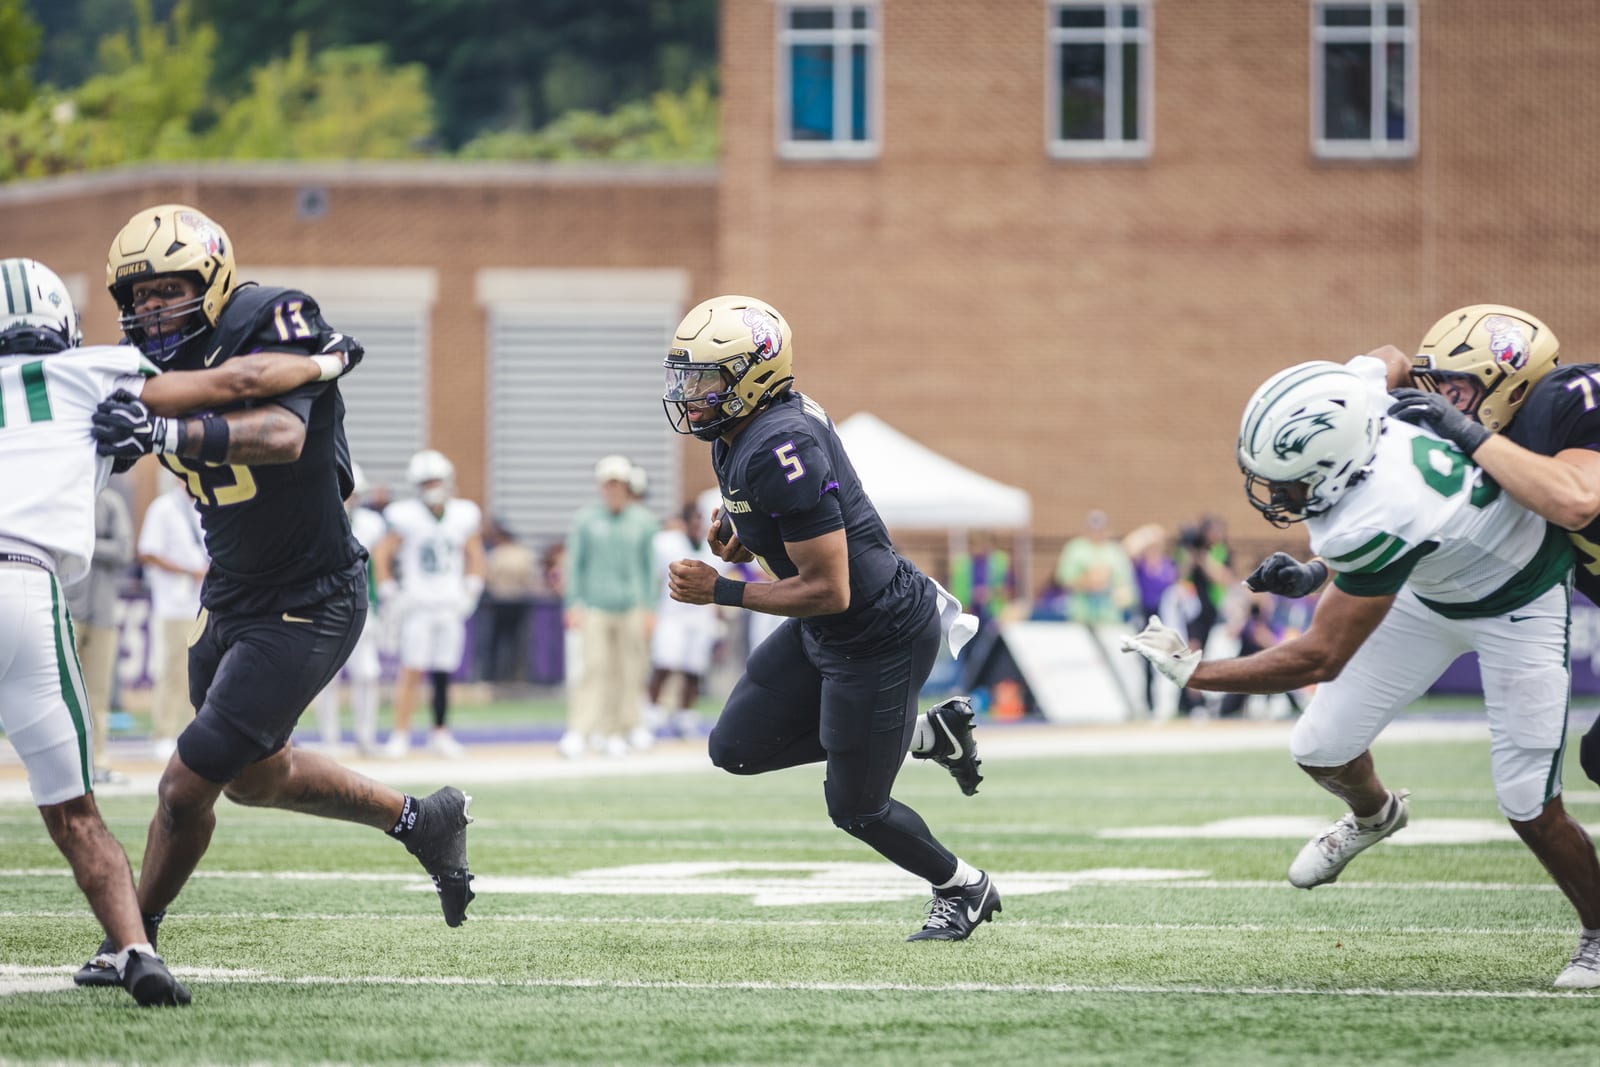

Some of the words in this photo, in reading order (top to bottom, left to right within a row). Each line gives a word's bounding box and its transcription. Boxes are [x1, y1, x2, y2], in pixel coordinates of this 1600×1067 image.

[117, 261, 147, 277] DUKES
[273, 300, 313, 343] 13
[0, 360, 54, 429] 1
[773, 440, 806, 485] 5
